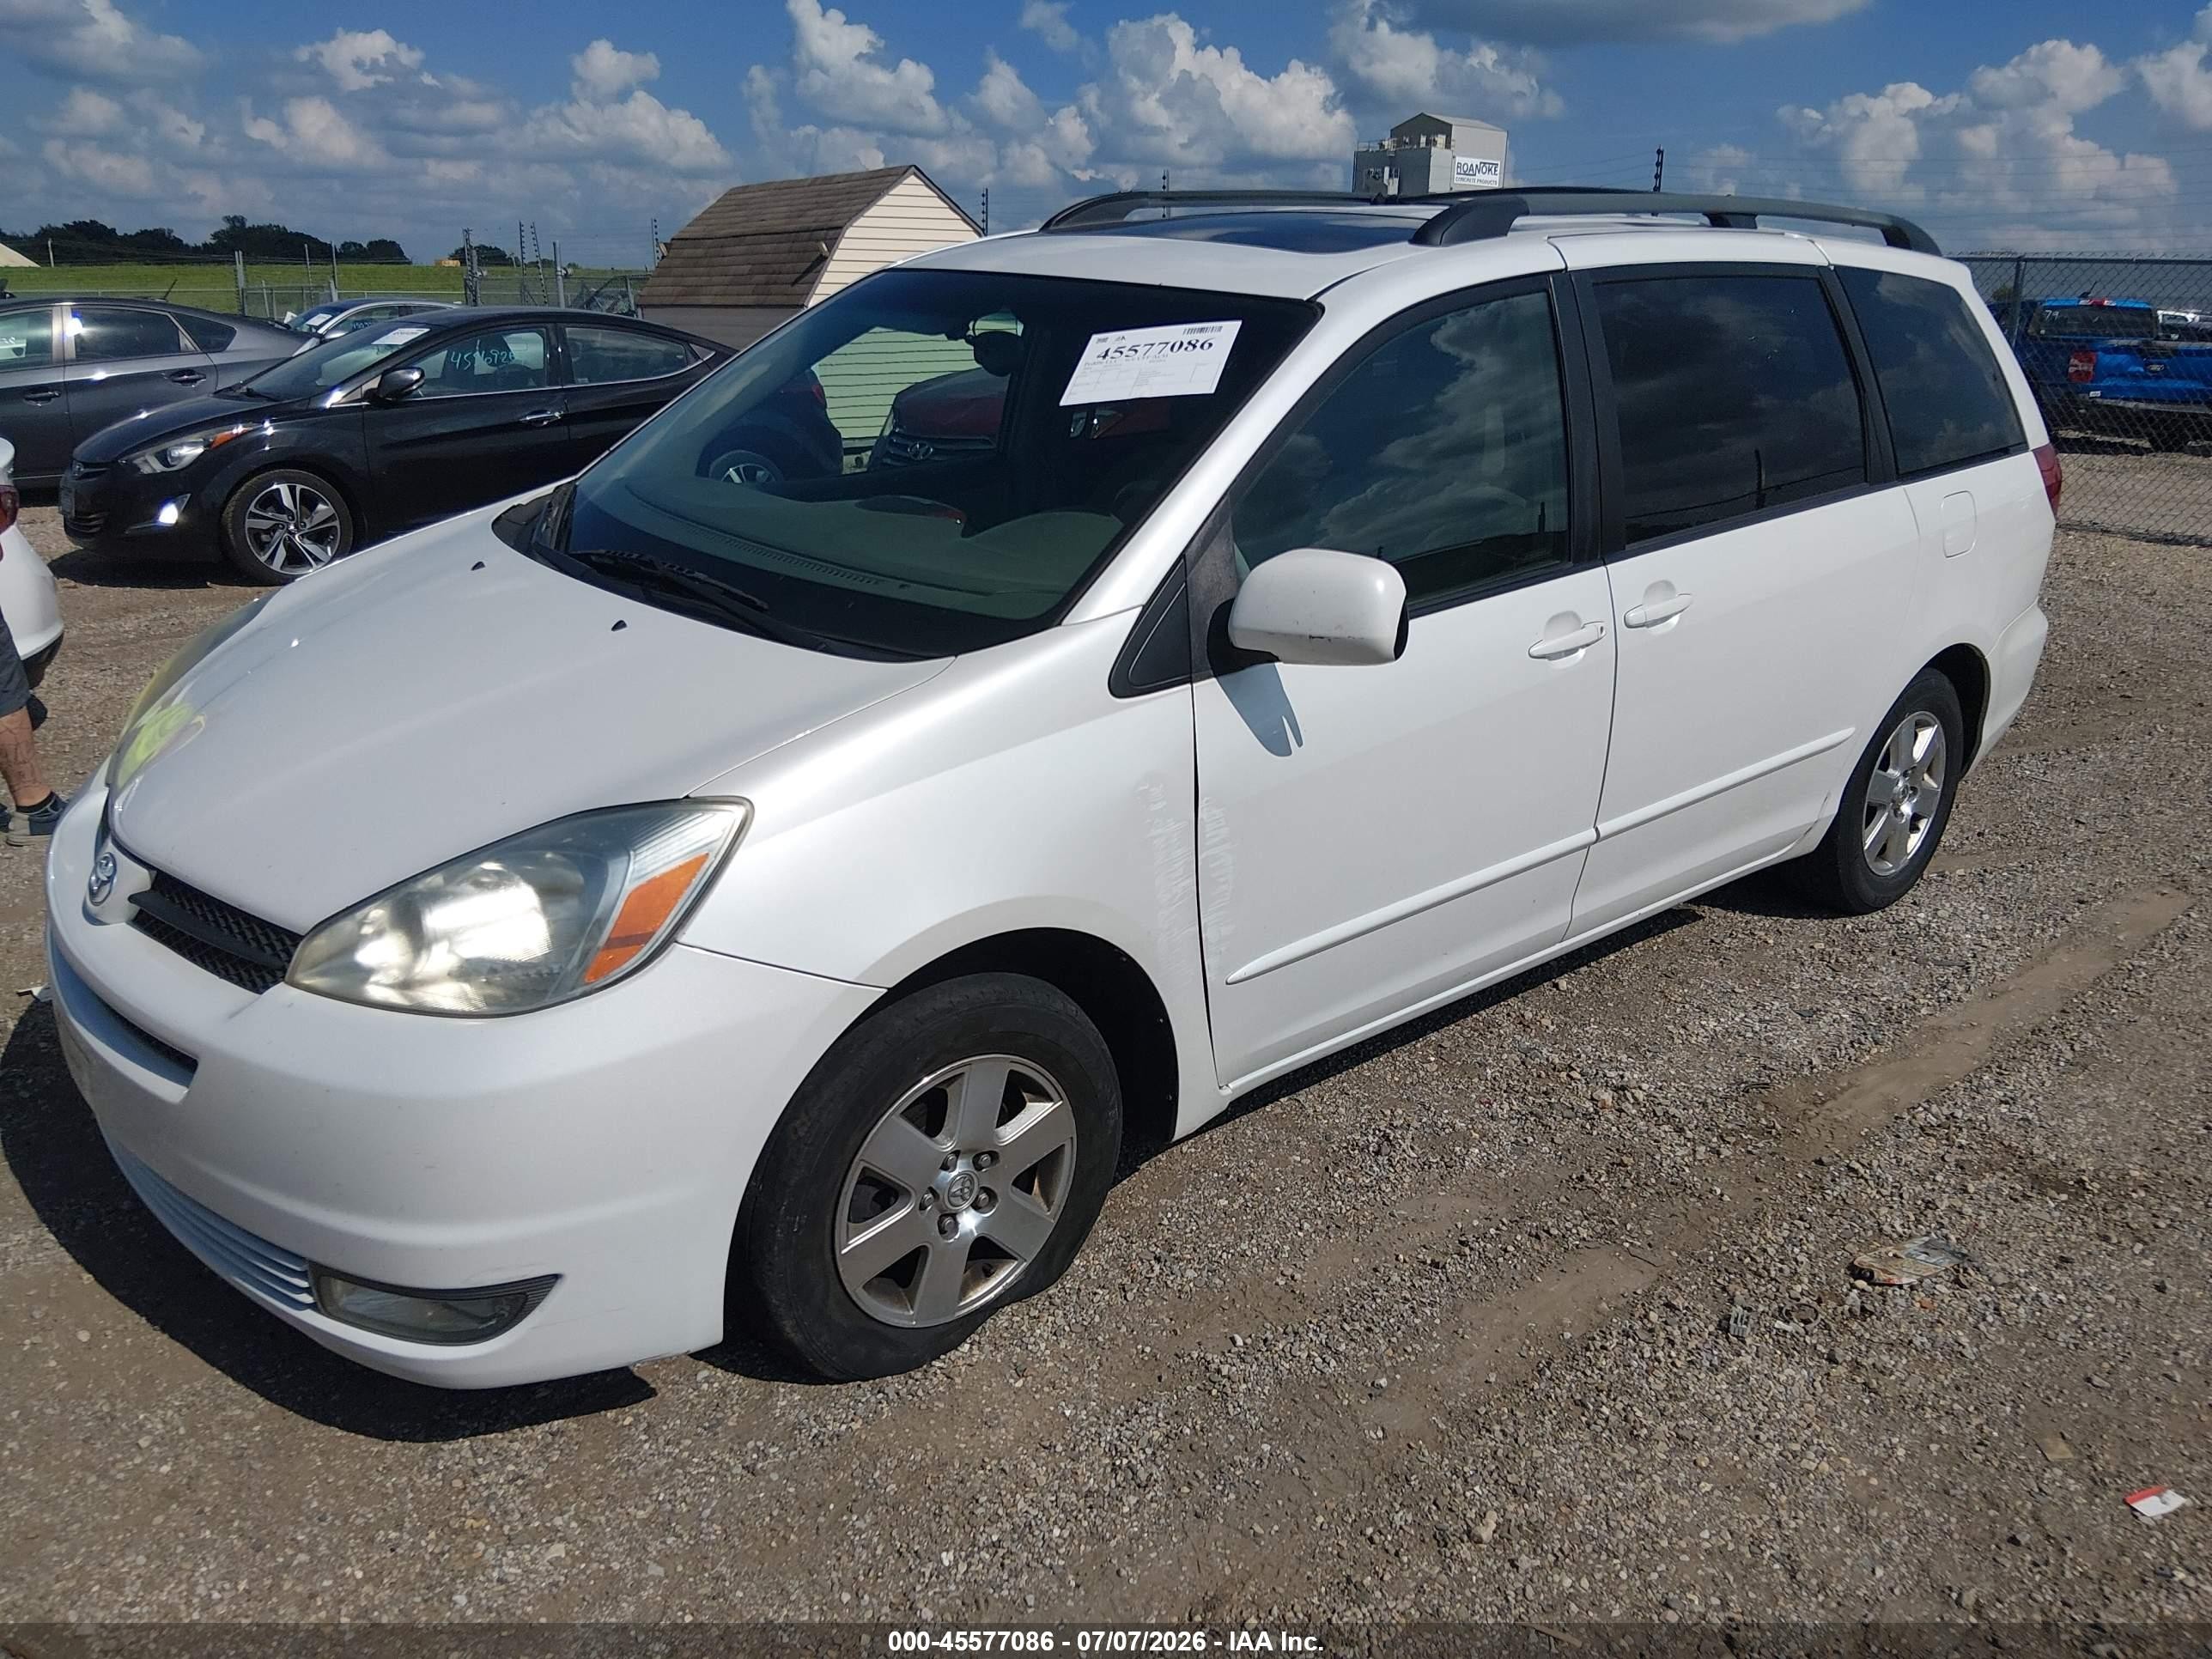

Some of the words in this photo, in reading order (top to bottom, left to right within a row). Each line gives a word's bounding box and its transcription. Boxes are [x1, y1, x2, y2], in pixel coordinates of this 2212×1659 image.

[1456, 161, 1499, 177] ROANOKE
[1476, 178, 1498, 186] PRODUCTS
[1096, 337, 1216, 361] 45577086
